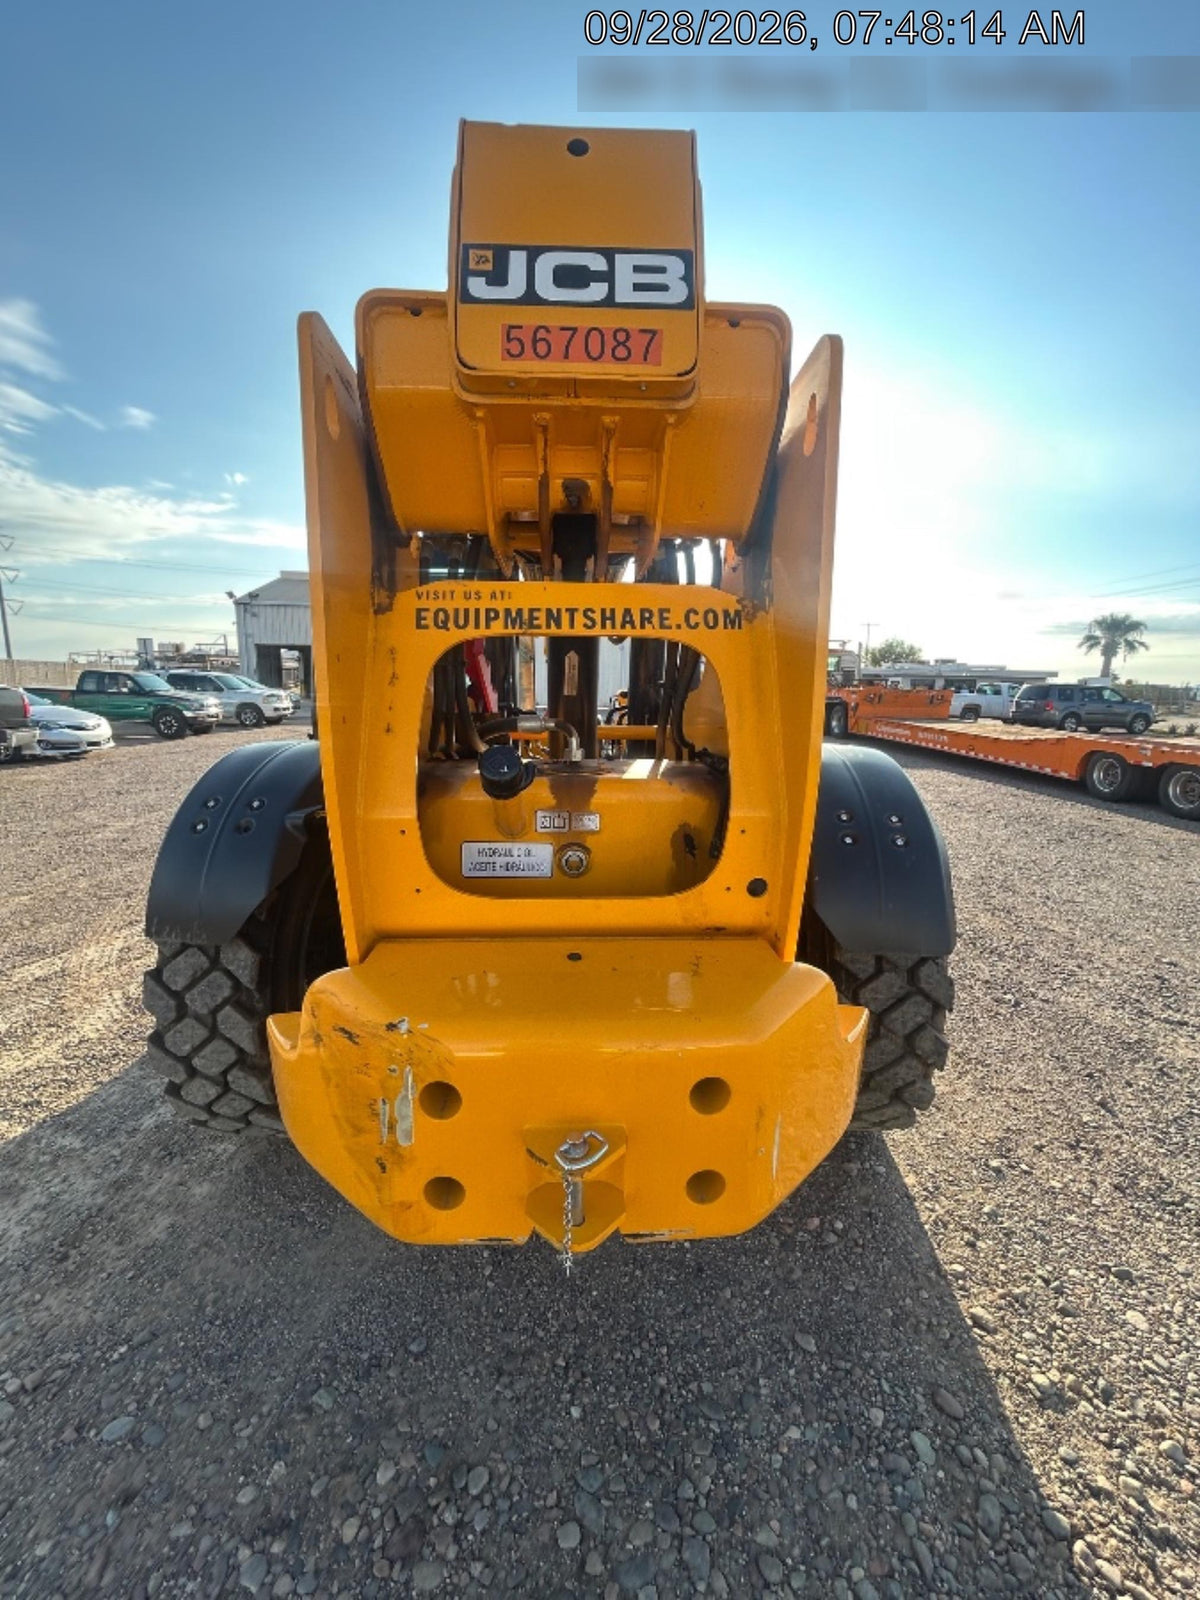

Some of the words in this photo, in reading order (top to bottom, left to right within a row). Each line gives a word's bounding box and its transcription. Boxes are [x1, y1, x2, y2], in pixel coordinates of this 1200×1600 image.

[467, 250, 689, 305] JCB
[504, 324, 659, 363] 567087
[415, 590, 456, 601] VISIT
[463, 590, 482, 601] US
[489, 591, 513, 601] AT:
[415, 607, 743, 631] EQUIPMENTSHARE.COM
